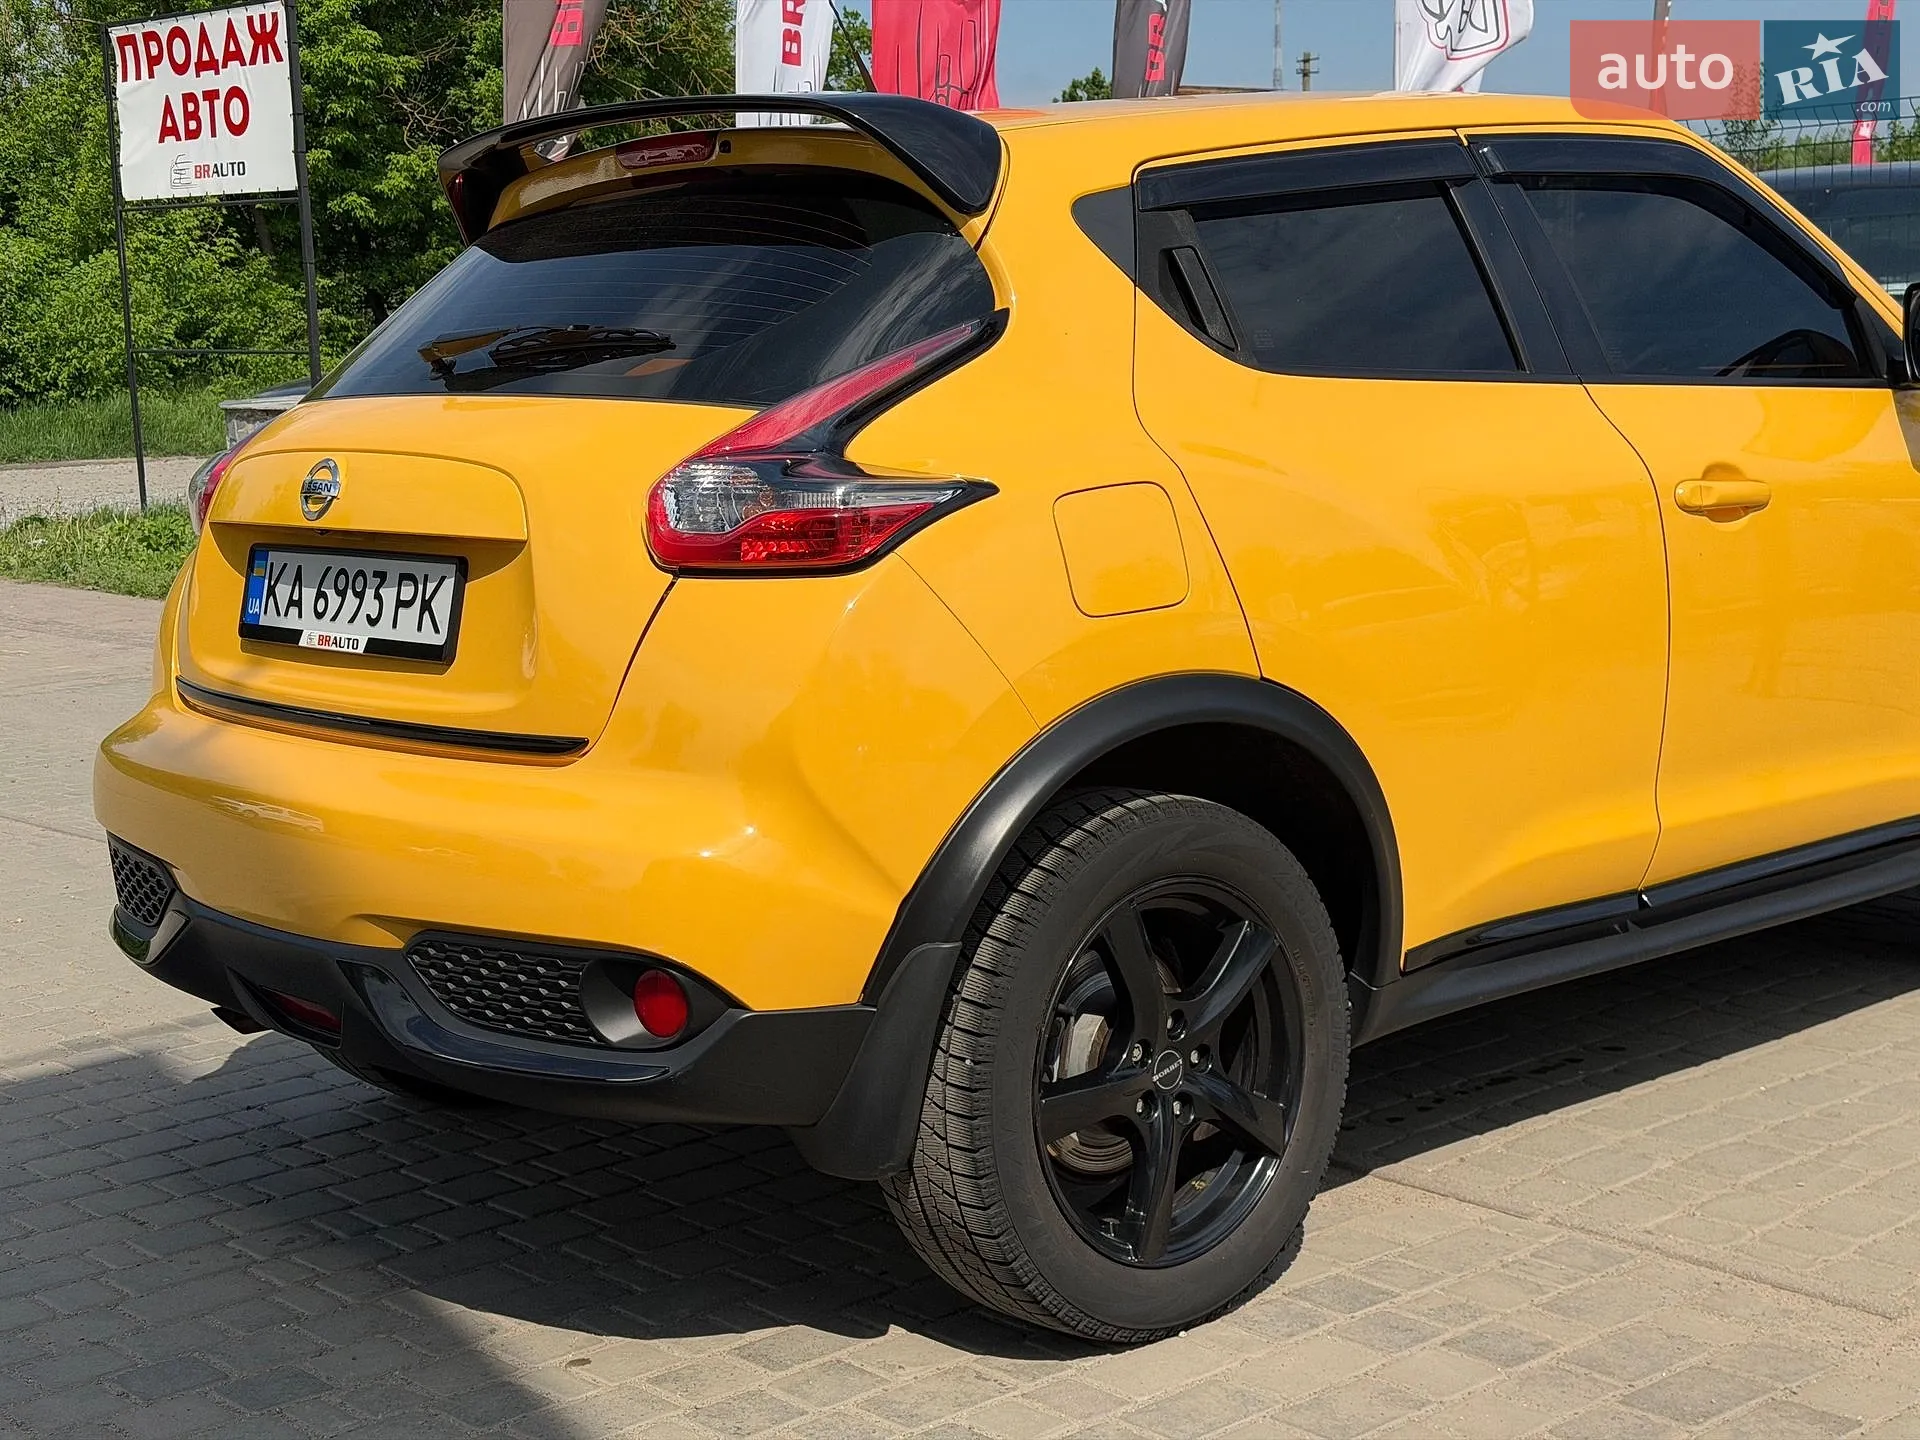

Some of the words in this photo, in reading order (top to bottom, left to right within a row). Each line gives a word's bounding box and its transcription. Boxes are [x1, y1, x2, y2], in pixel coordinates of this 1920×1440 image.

[551, 0, 584, 46] B
[116, 11, 284, 83] ПРОДАЖ
[158, 85, 250, 144] АВТО
[194, 161, 246, 179] BRAUTO
[248, 598, 260, 615] UA
[263, 562, 303, 619] KA
[313, 565, 388, 628] 6993
[391, 572, 447, 635] PK
[317, 634, 359, 650] BRAUTO
[1152, 1057, 1183, 1082] BORBET
